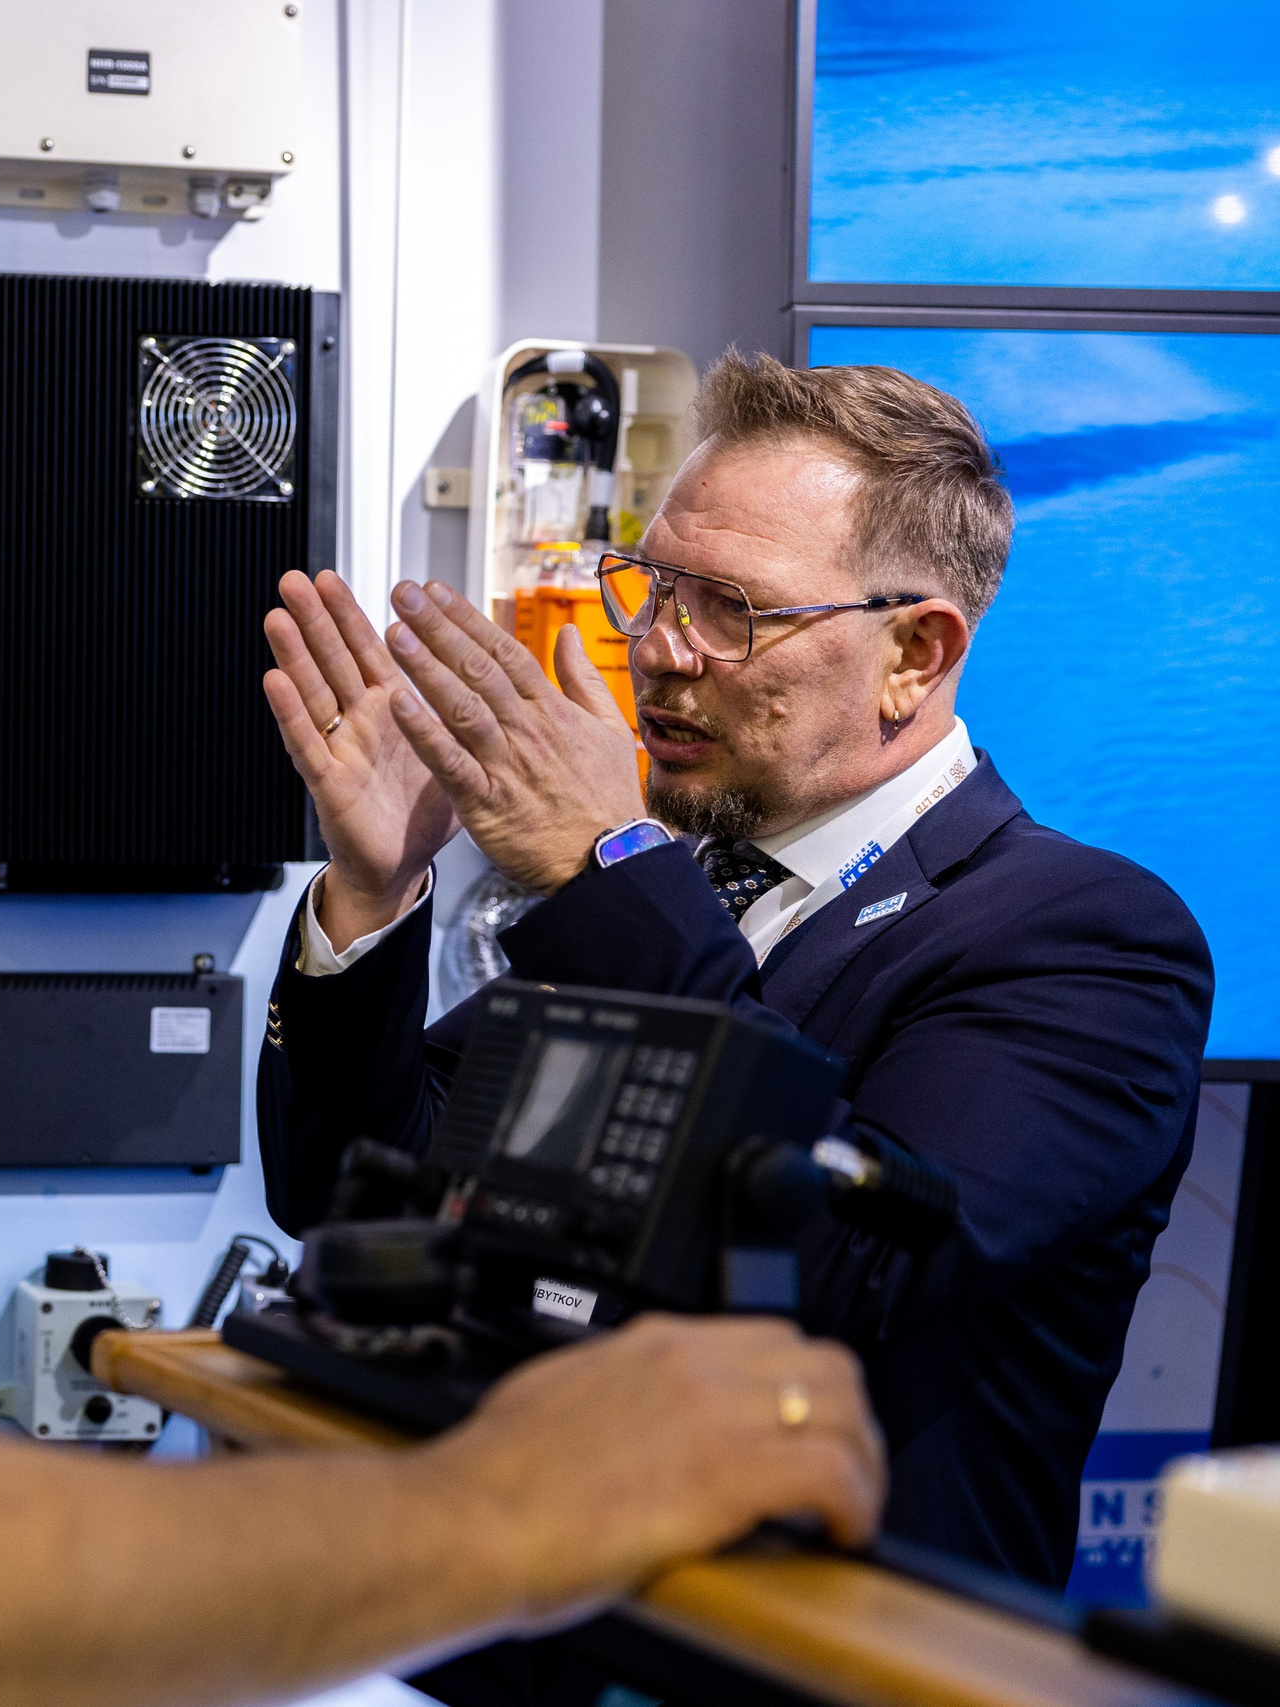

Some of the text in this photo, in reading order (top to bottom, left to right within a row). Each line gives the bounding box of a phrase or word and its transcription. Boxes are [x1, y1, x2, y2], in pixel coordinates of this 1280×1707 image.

[915, 797, 932, 815] LTD
[863, 897, 901, 916] NSR
[533, 1287, 582, 1308] IBYTKOV
